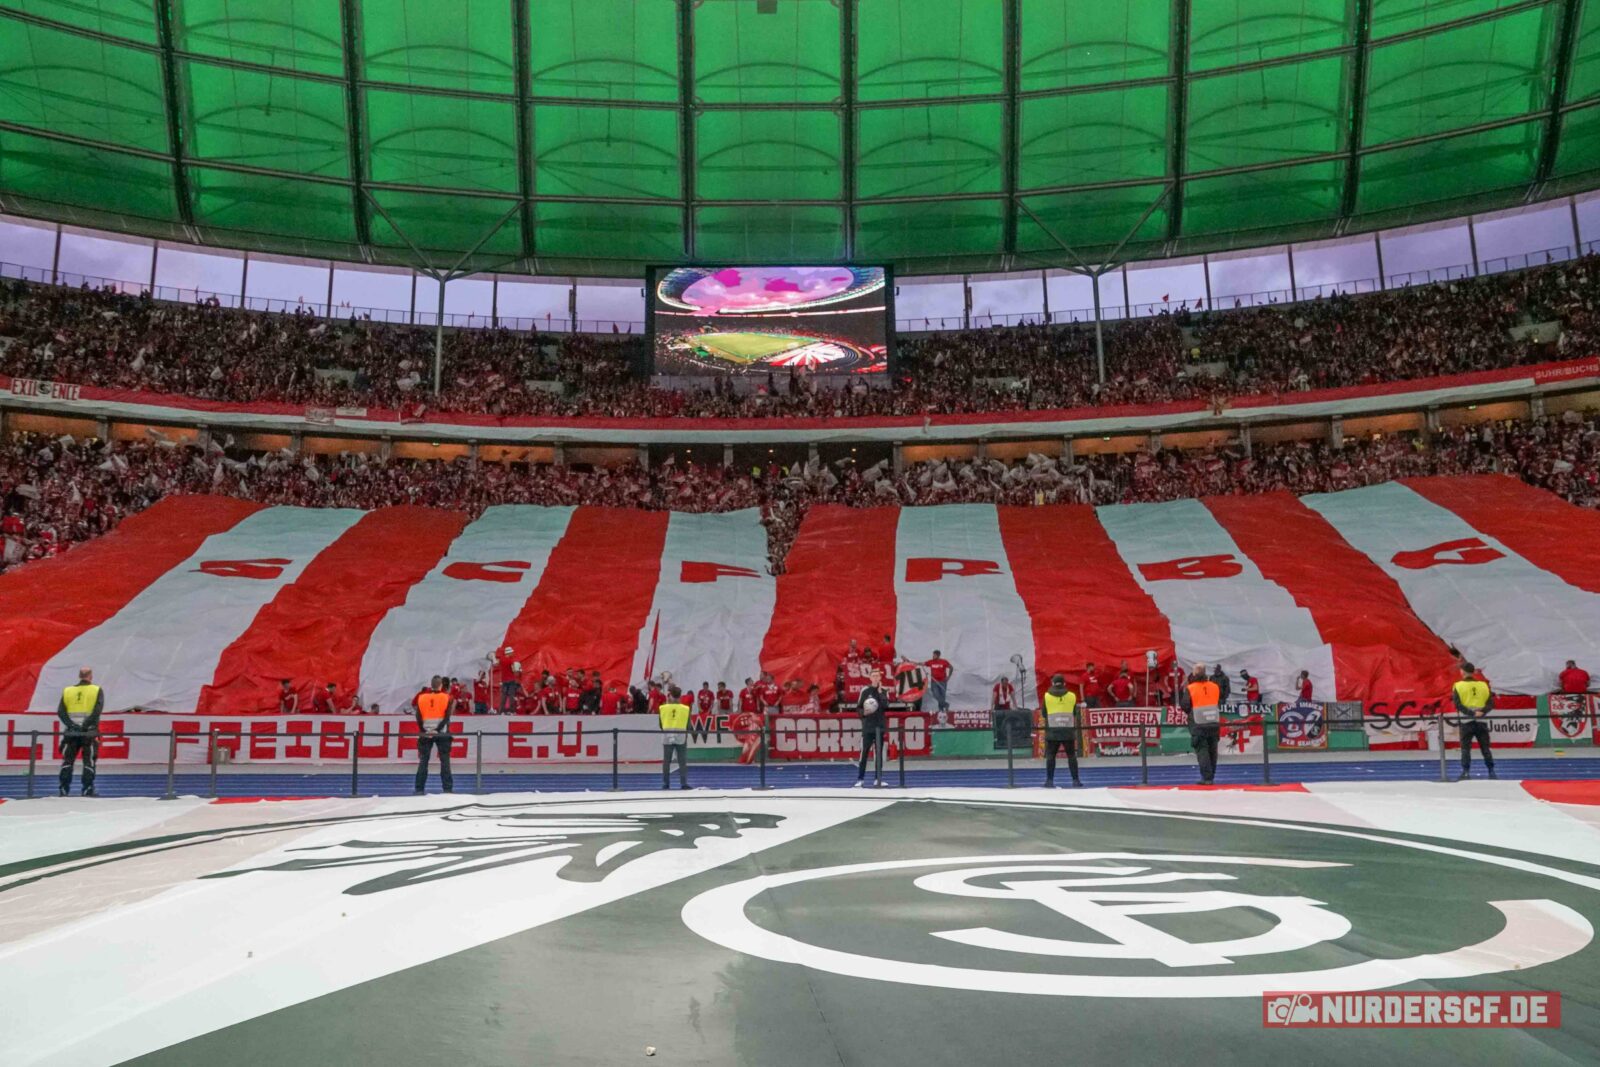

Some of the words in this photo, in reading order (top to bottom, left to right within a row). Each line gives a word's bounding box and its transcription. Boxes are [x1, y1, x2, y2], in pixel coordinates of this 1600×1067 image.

[11, 378, 38, 396] EXIL
[1091, 712, 1158, 725] SYNTHESIA
[1096, 727, 1140, 738] ULTRAS
